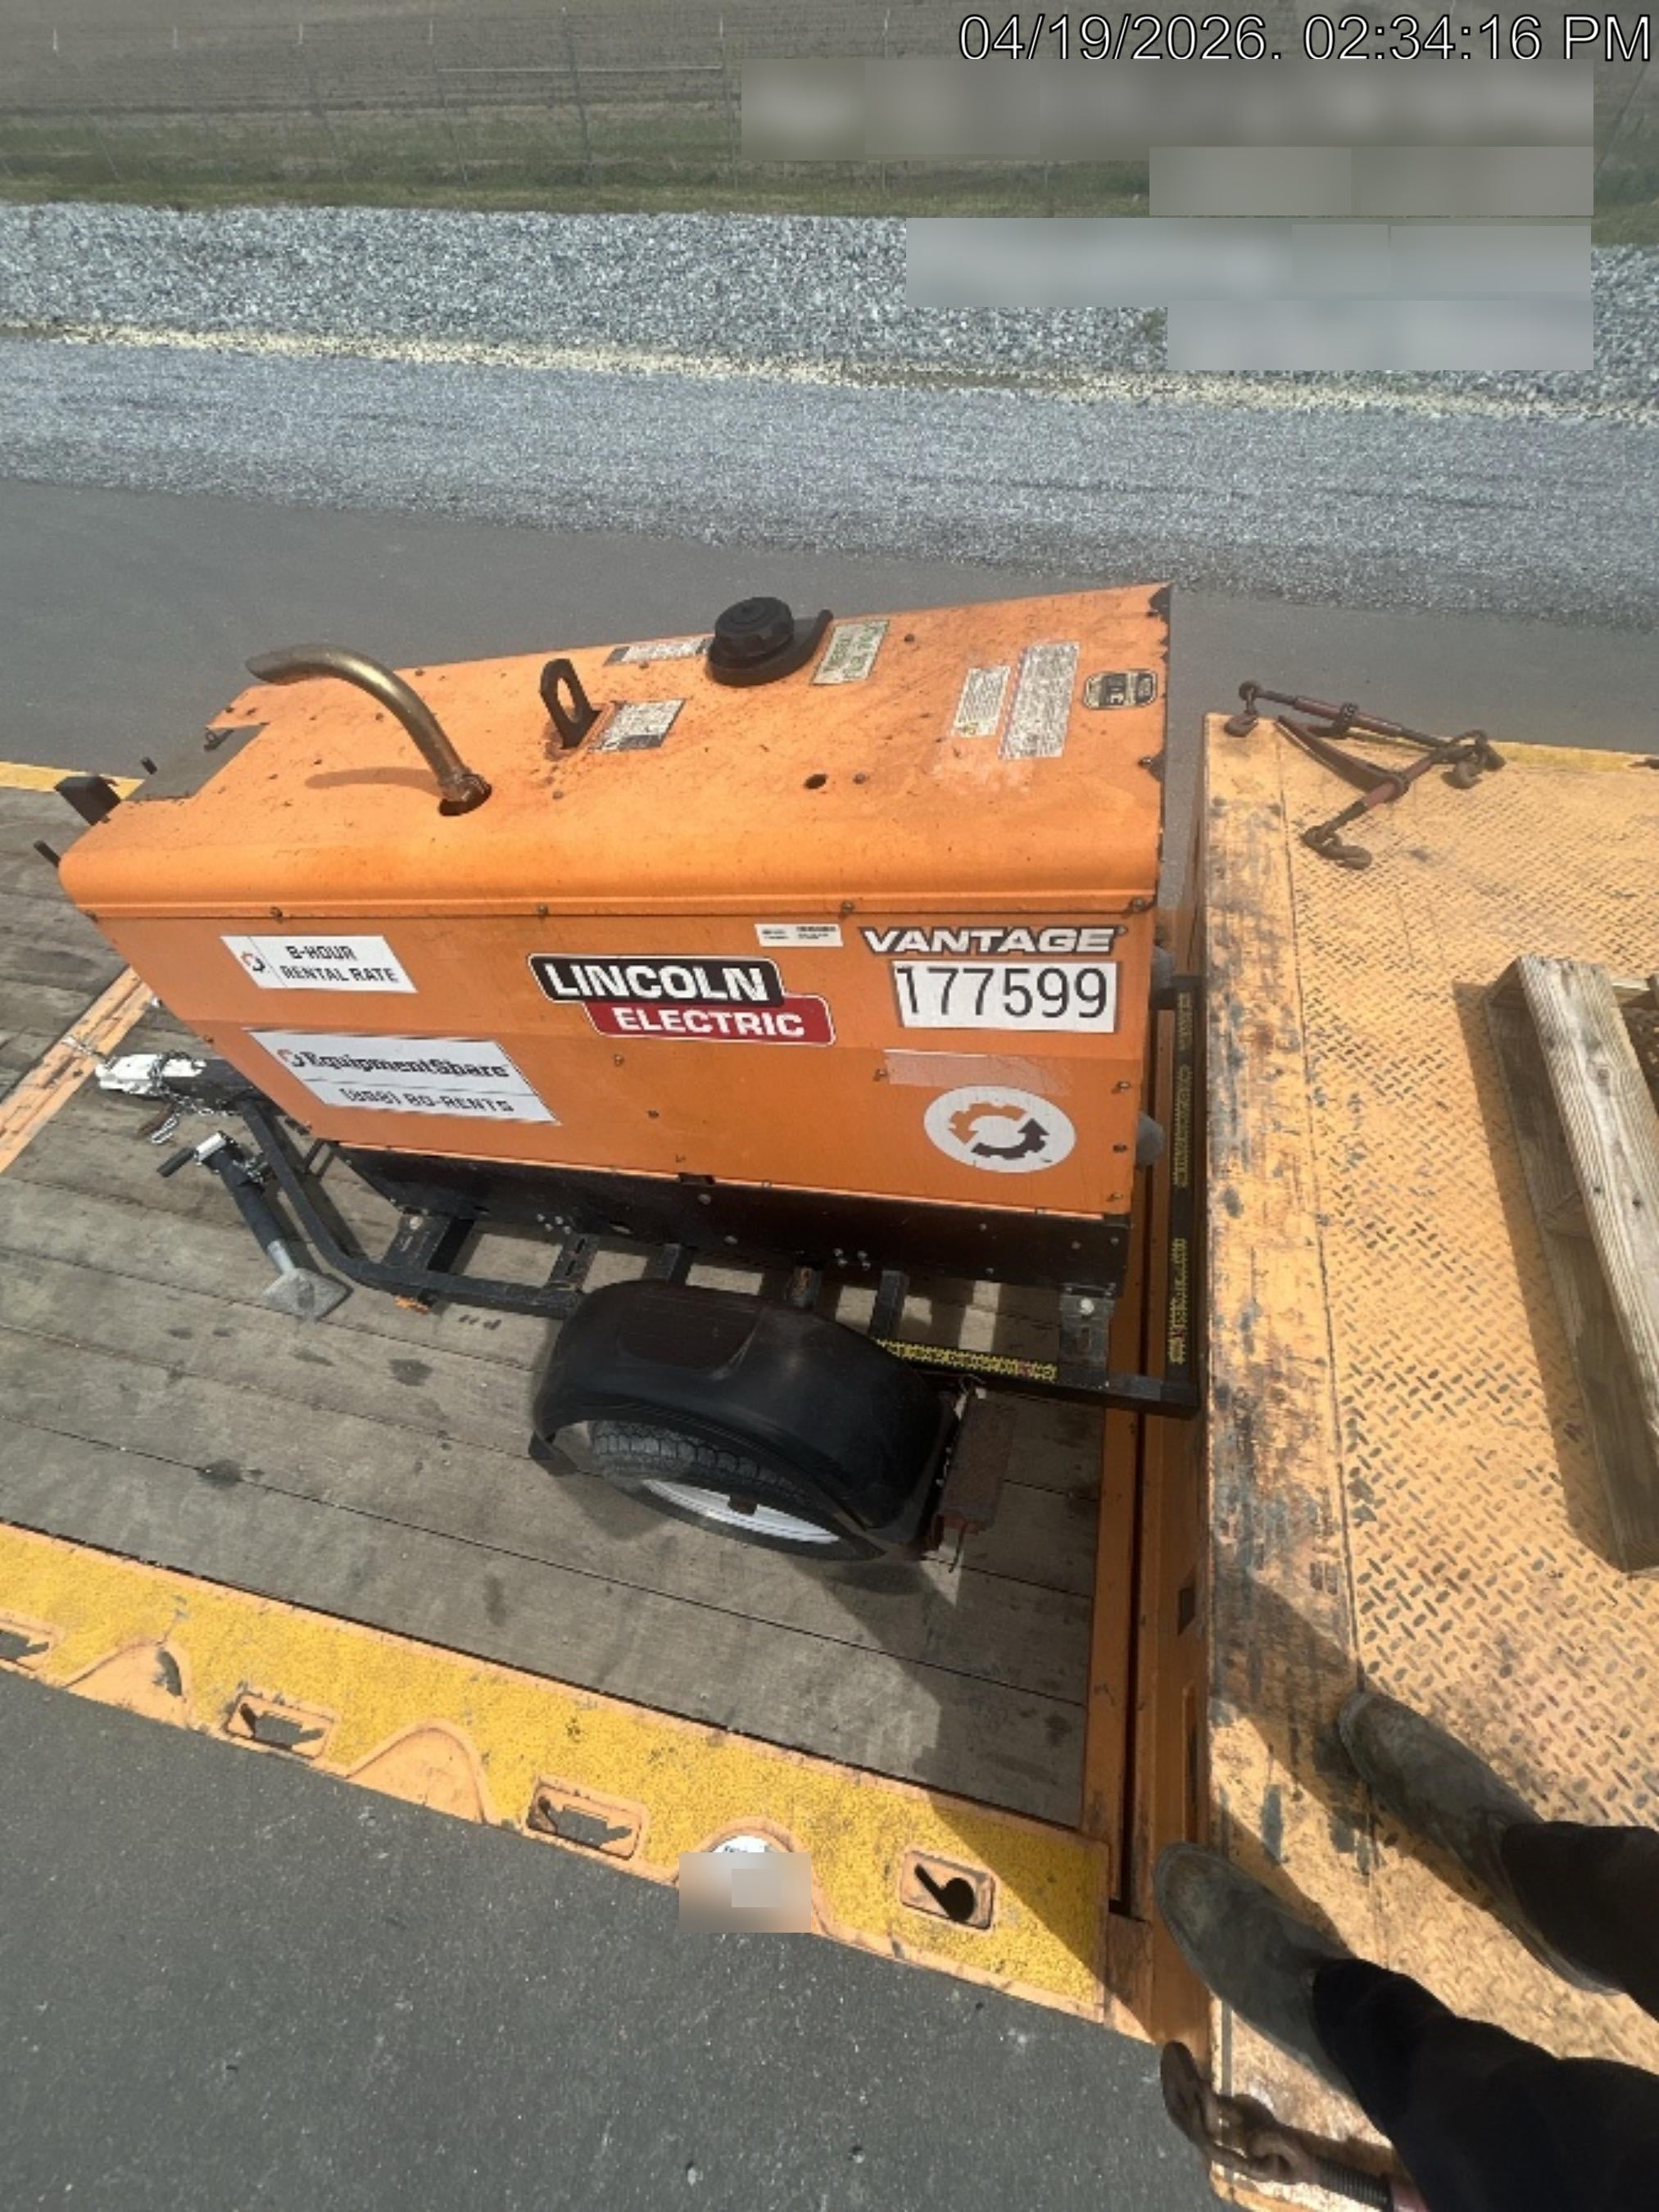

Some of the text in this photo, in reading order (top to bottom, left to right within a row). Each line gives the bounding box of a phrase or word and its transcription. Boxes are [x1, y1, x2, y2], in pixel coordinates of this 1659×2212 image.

[860, 927, 1115, 954] VANTAGE
[279, 965, 399, 983] RENTAL RATE
[544, 963, 769, 1002] LINCOLN
[895, 967, 1108, 1018] 177599
[611, 1006, 805, 1037] ELECTRIC
[300, 1051, 509, 1077] EquipmentShare
